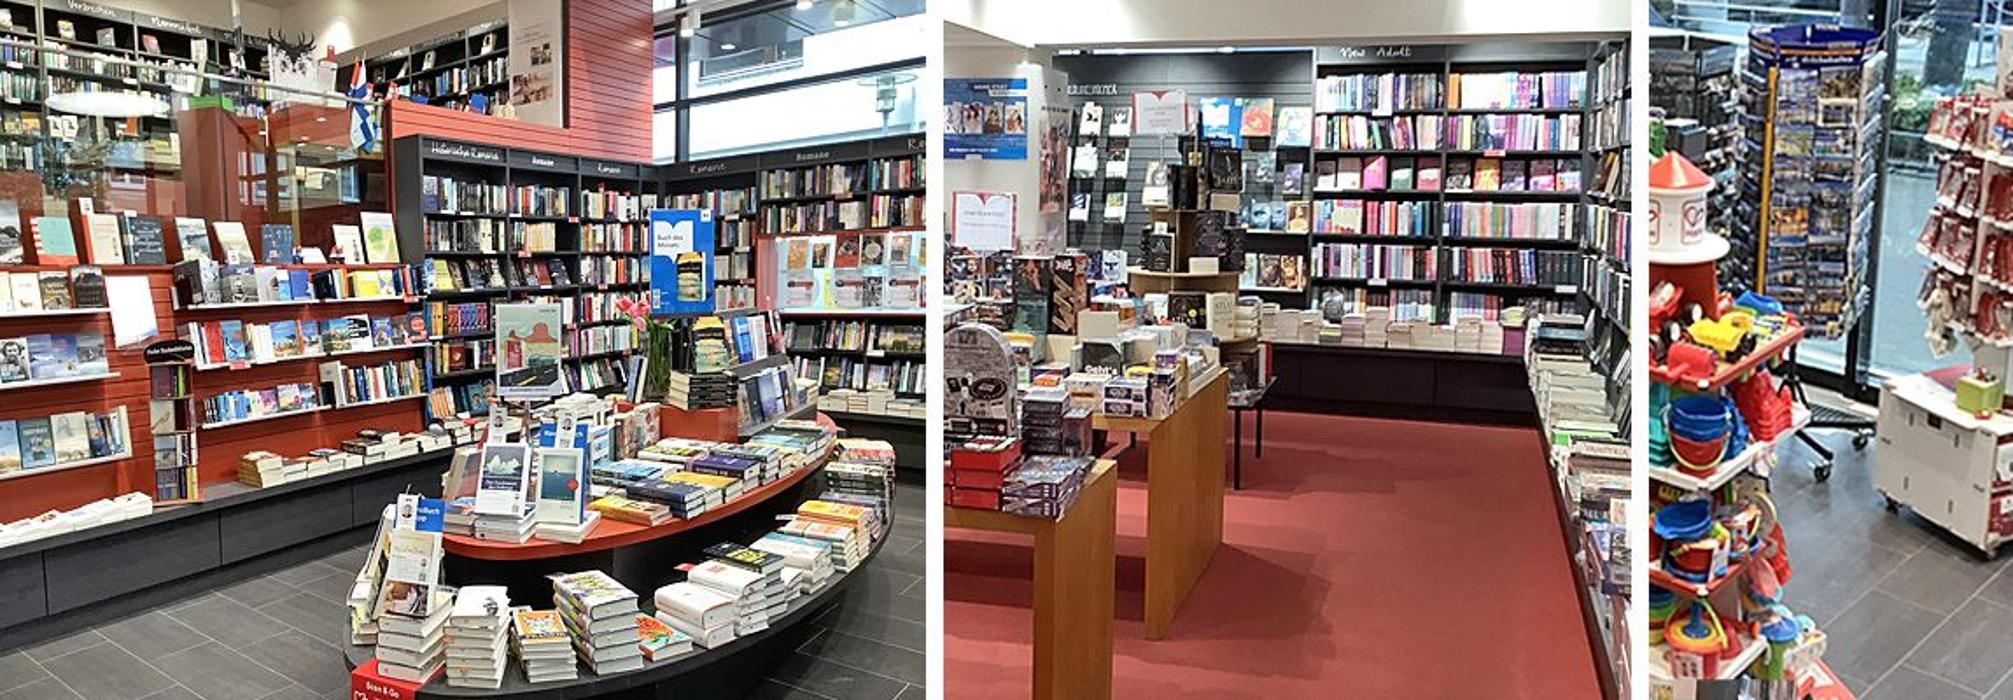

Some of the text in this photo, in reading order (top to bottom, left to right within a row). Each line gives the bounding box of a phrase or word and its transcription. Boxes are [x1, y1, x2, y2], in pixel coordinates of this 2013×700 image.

[1339, 45, 1411, 58] New Adult
[470, 146, 499, 160] Romane
[796, 151, 829, 161] Romane
[366, 681, 400, 699] Scan & Go
